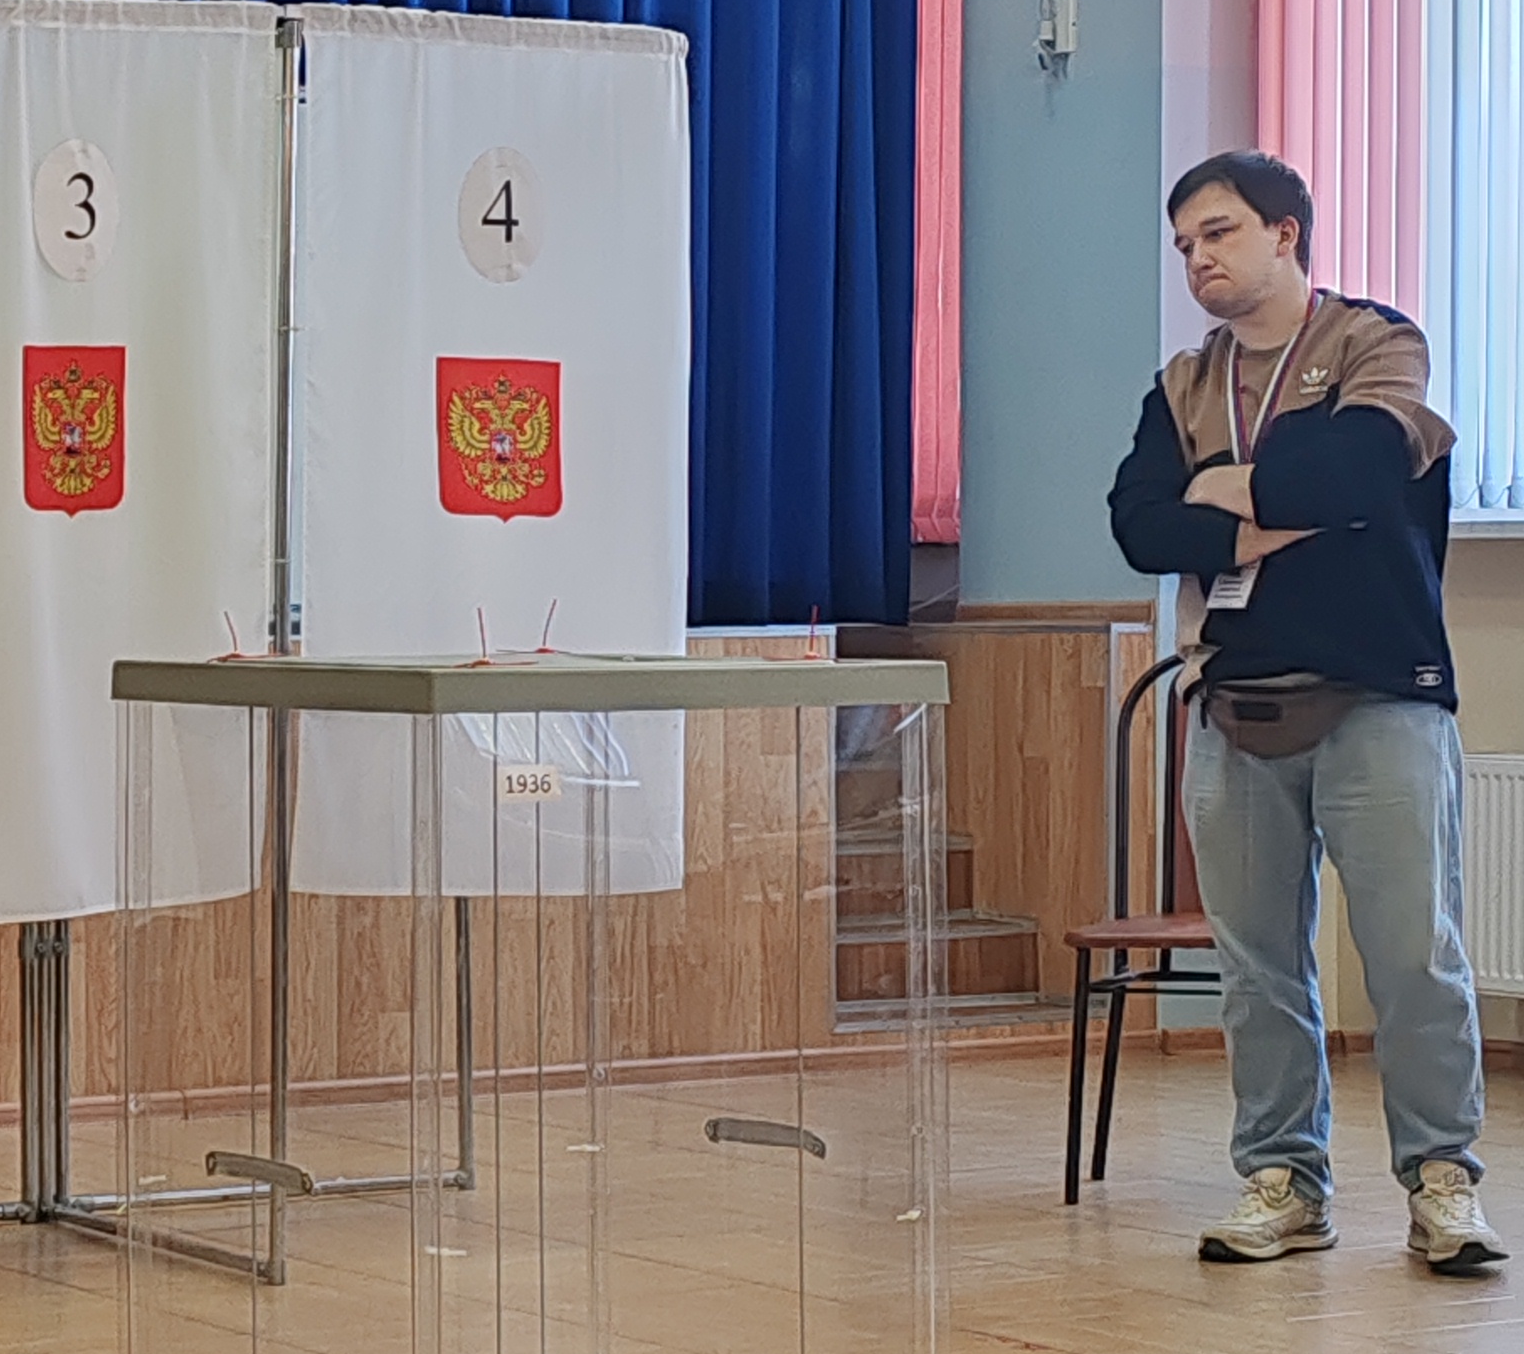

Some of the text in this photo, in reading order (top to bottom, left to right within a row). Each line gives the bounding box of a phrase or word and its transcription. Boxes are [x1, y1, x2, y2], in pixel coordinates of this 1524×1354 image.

[64, 172, 96, 240] 3
[481, 180, 520, 243] 4
[505, 773, 552, 794] 1936
